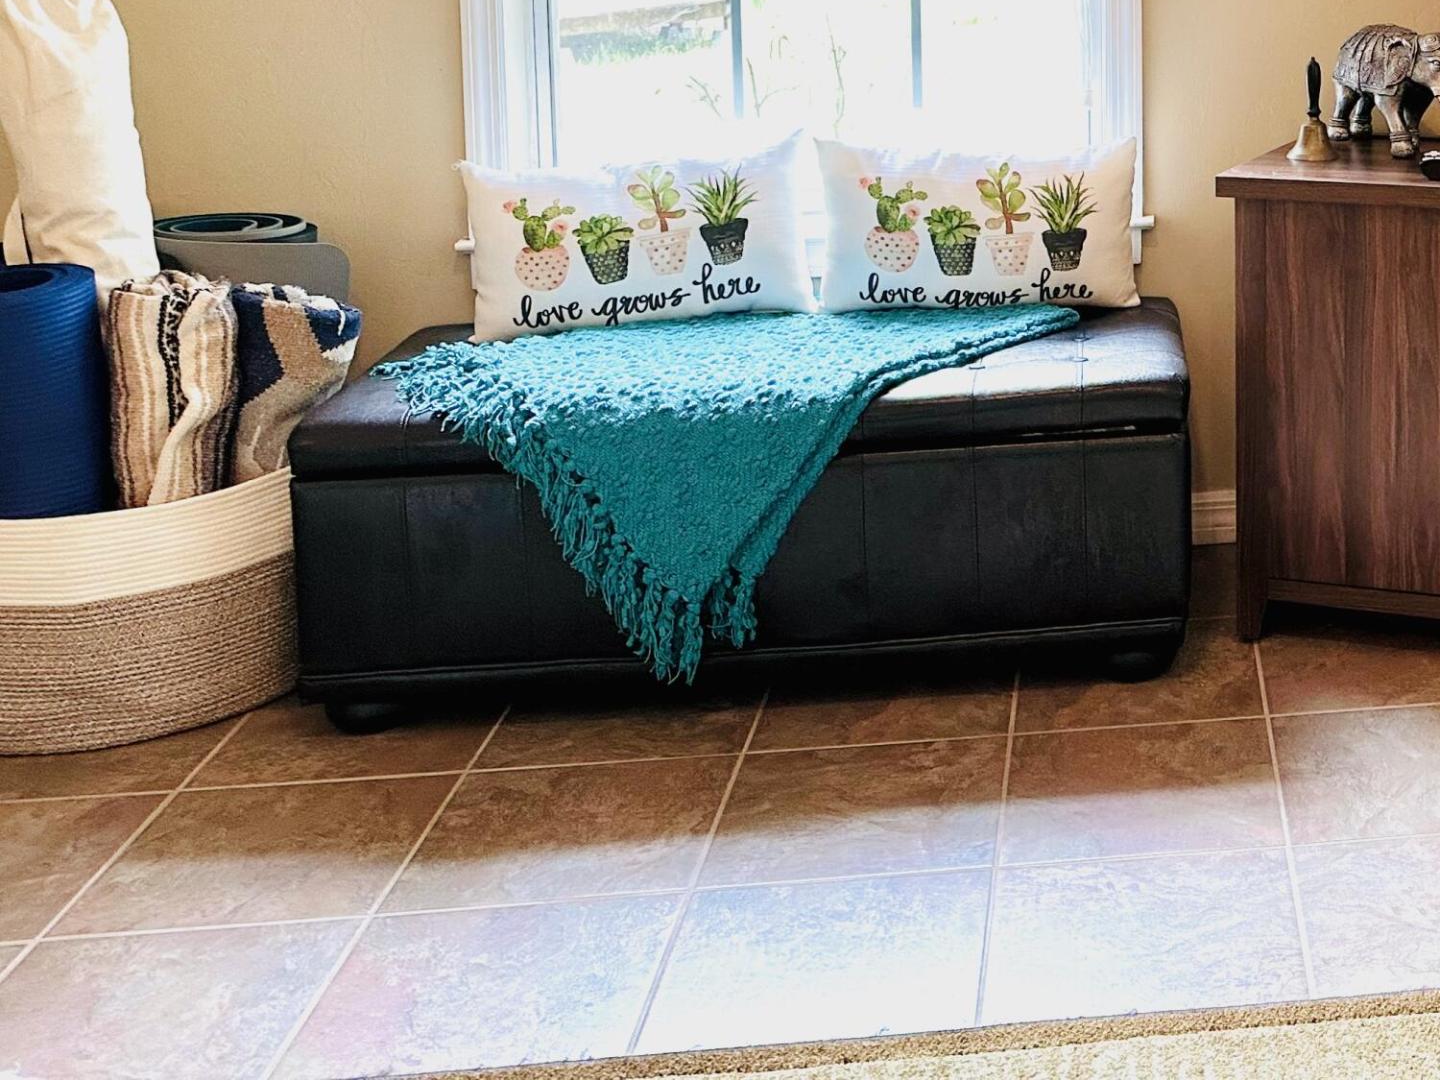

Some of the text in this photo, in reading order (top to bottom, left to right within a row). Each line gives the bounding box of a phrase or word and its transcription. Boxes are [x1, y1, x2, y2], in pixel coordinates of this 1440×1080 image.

[513, 262, 761, 329] love grows here
[859, 267, 1094, 309] love grows here
